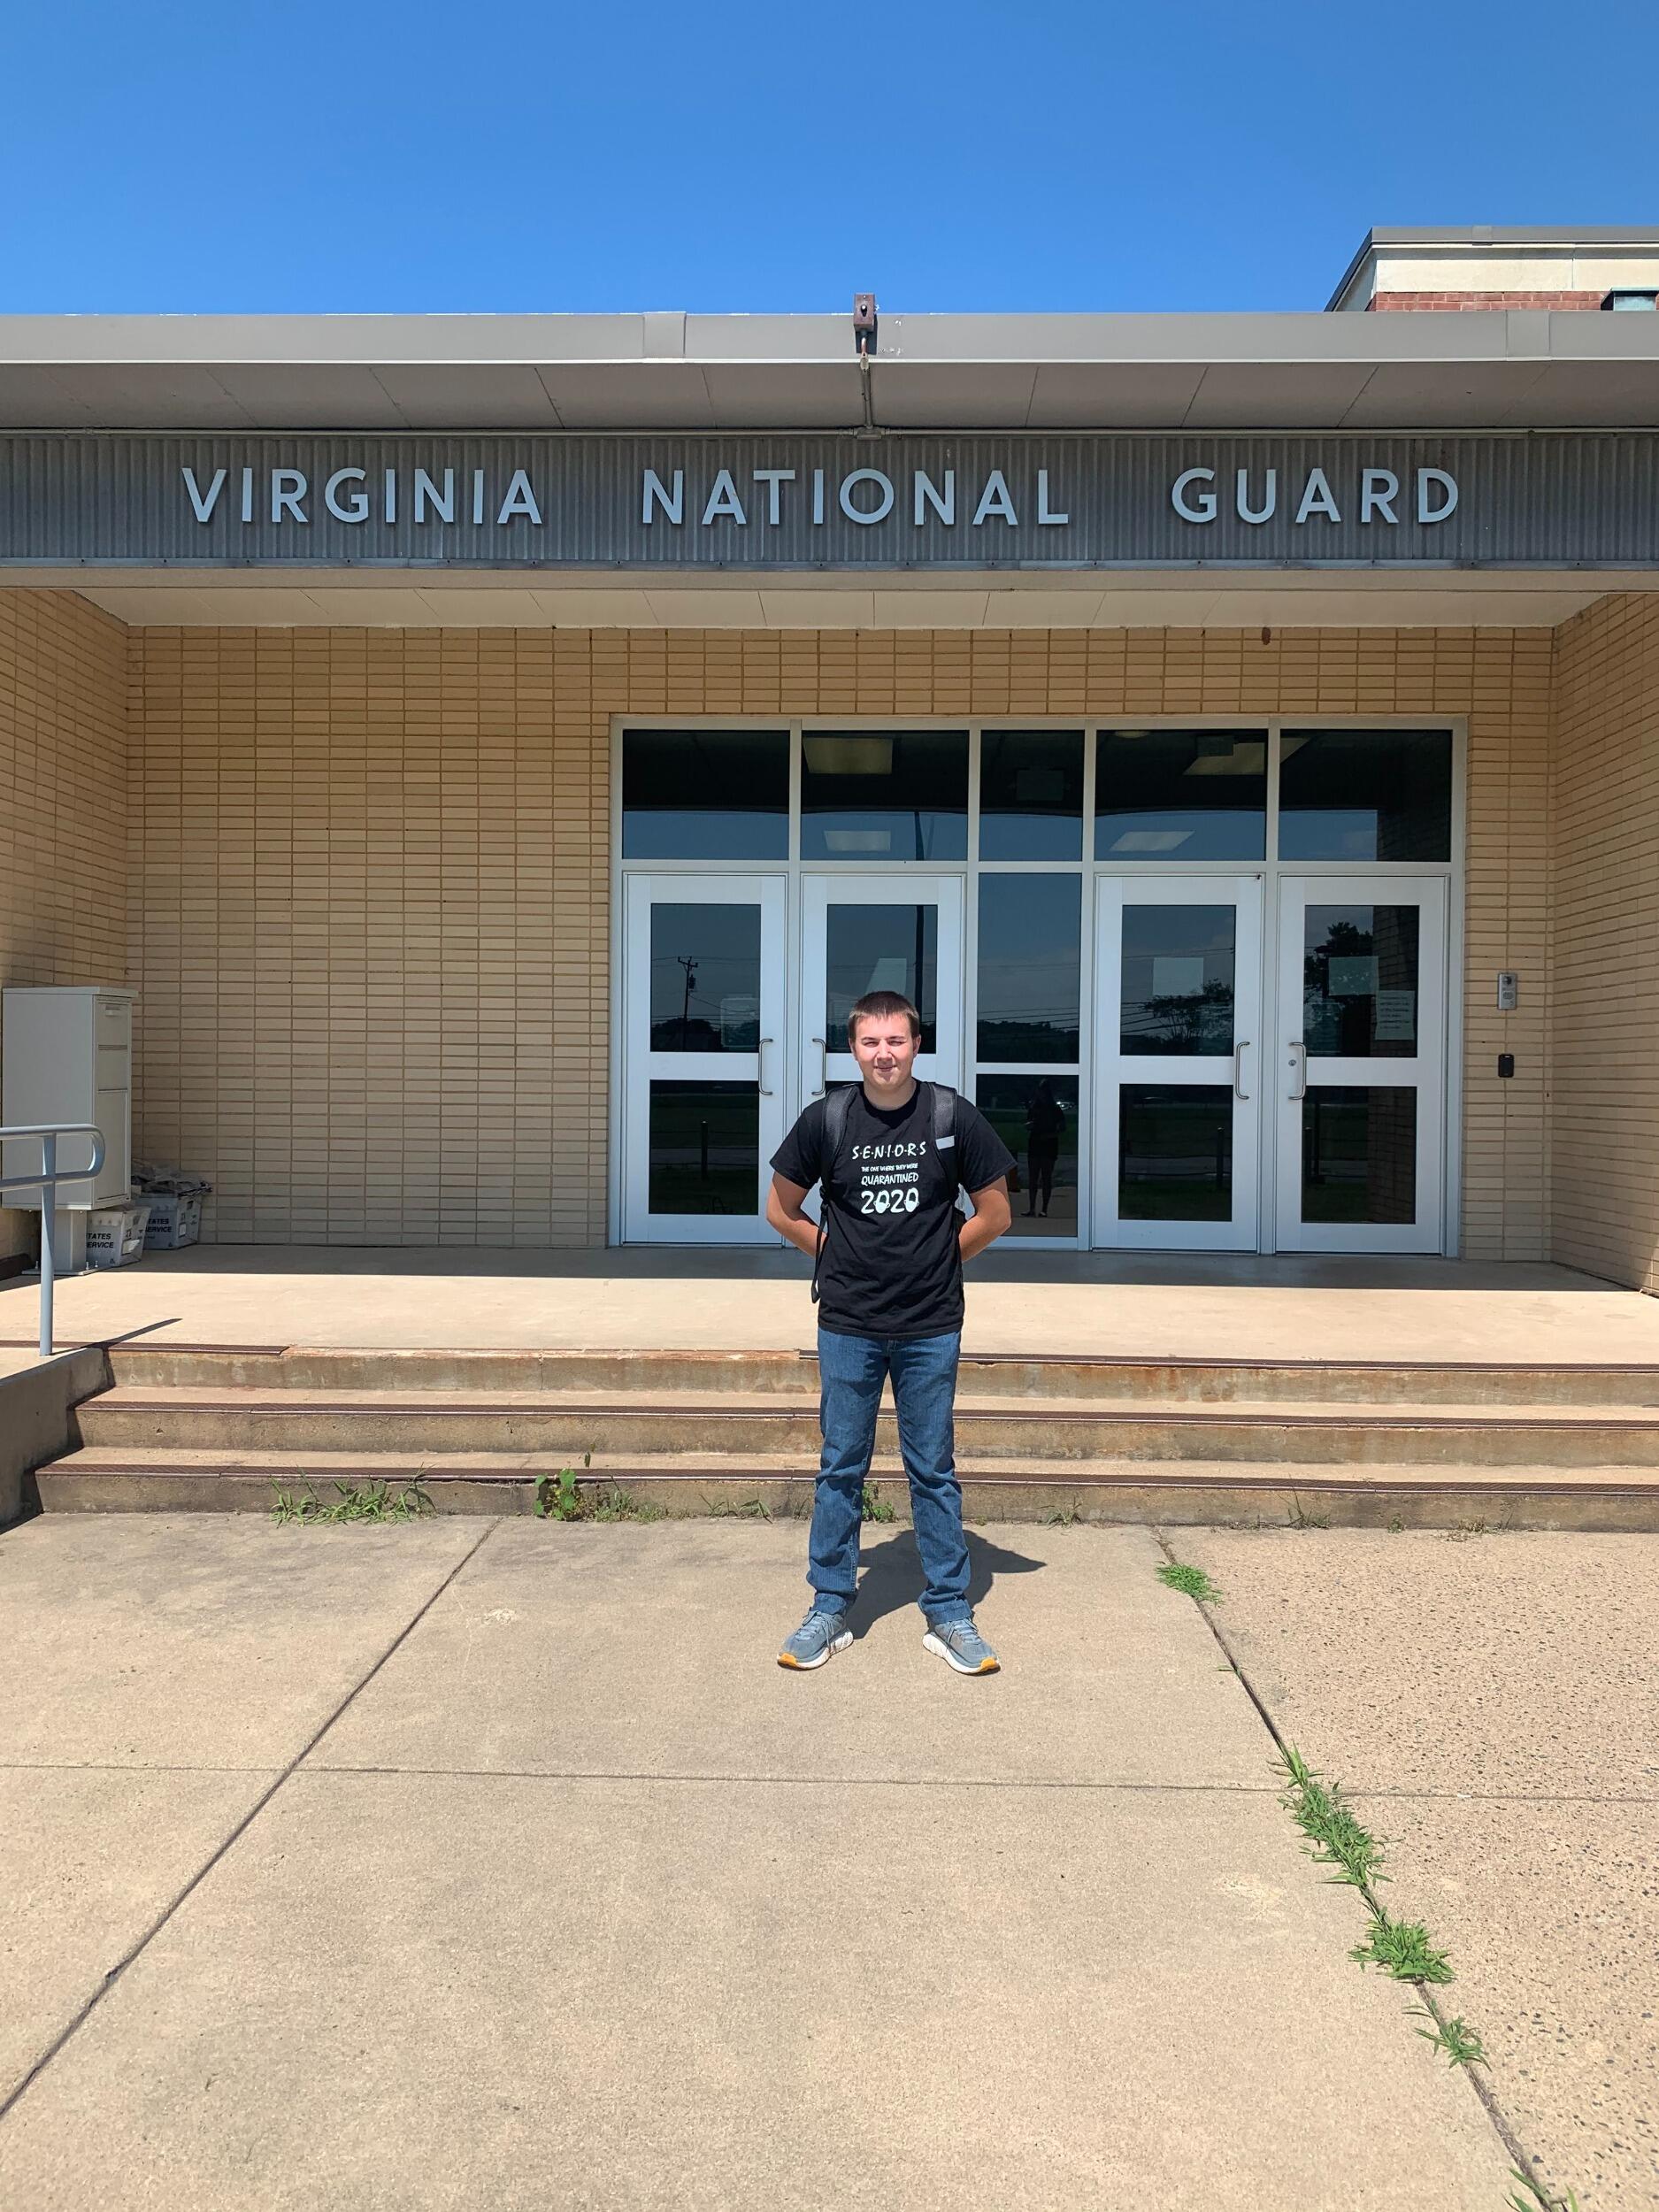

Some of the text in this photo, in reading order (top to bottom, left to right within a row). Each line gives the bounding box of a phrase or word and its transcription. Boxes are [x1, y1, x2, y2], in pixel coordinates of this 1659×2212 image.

[181, 467, 1459, 526] VIRGINIA NATIONAL GUARD
[861, 1172, 919, 1187] QUARANTINED
[861, 1187, 920, 1214] 2020
